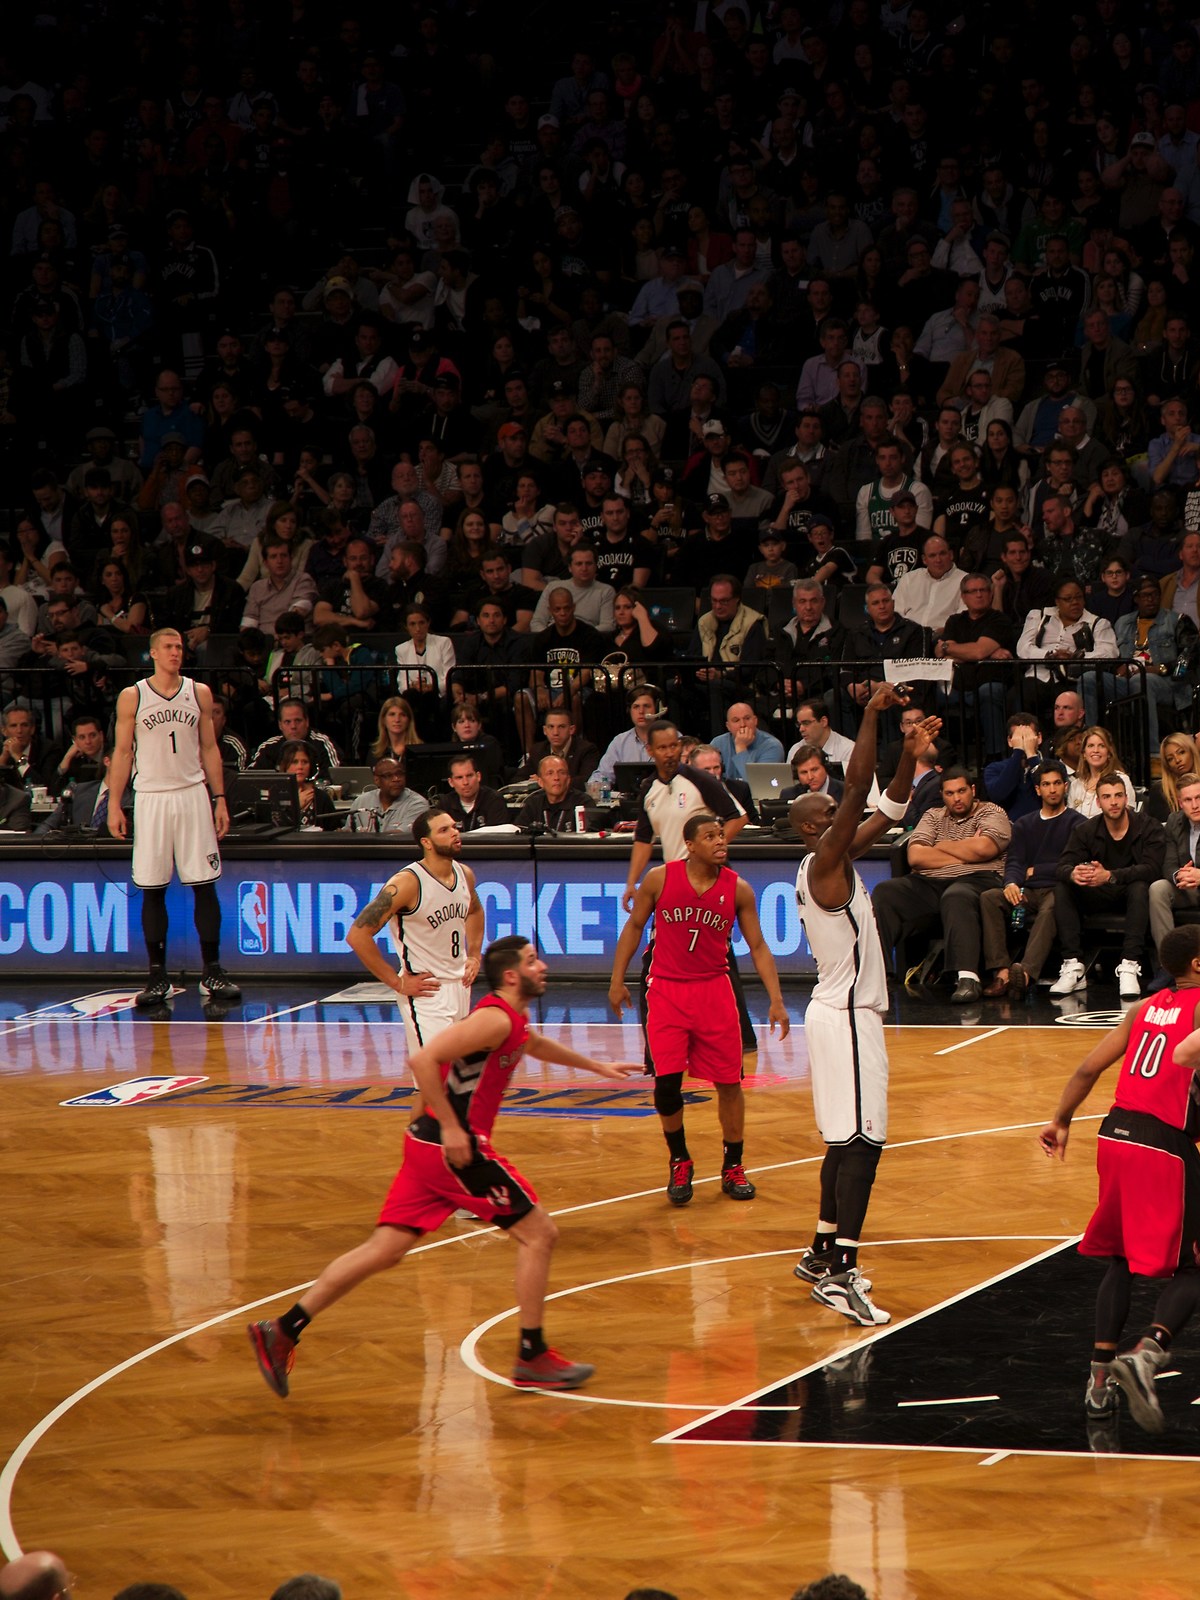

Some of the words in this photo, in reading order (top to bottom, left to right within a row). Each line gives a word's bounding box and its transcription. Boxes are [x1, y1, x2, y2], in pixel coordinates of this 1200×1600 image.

[946, 501, 986, 516] BROOKLYN
[789, 512, 812, 527] NET
[871, 510, 898, 528] CELTIC
[597, 552, 634, 569] ROOKLYN
[889, 550, 917, 564] NETS
[142, 709, 197, 730] BROOKLYN
[169, 731, 177, 754] 1
[661, 906, 729, 931] RAPTORS
[243, 939, 260, 950] NBA
[451, 930, 460, 958] 8
[688, 929, 700, 952] 7
[1130, 1030, 1168, 1079] 10
[73, 1097, 120, 1105] NBA
